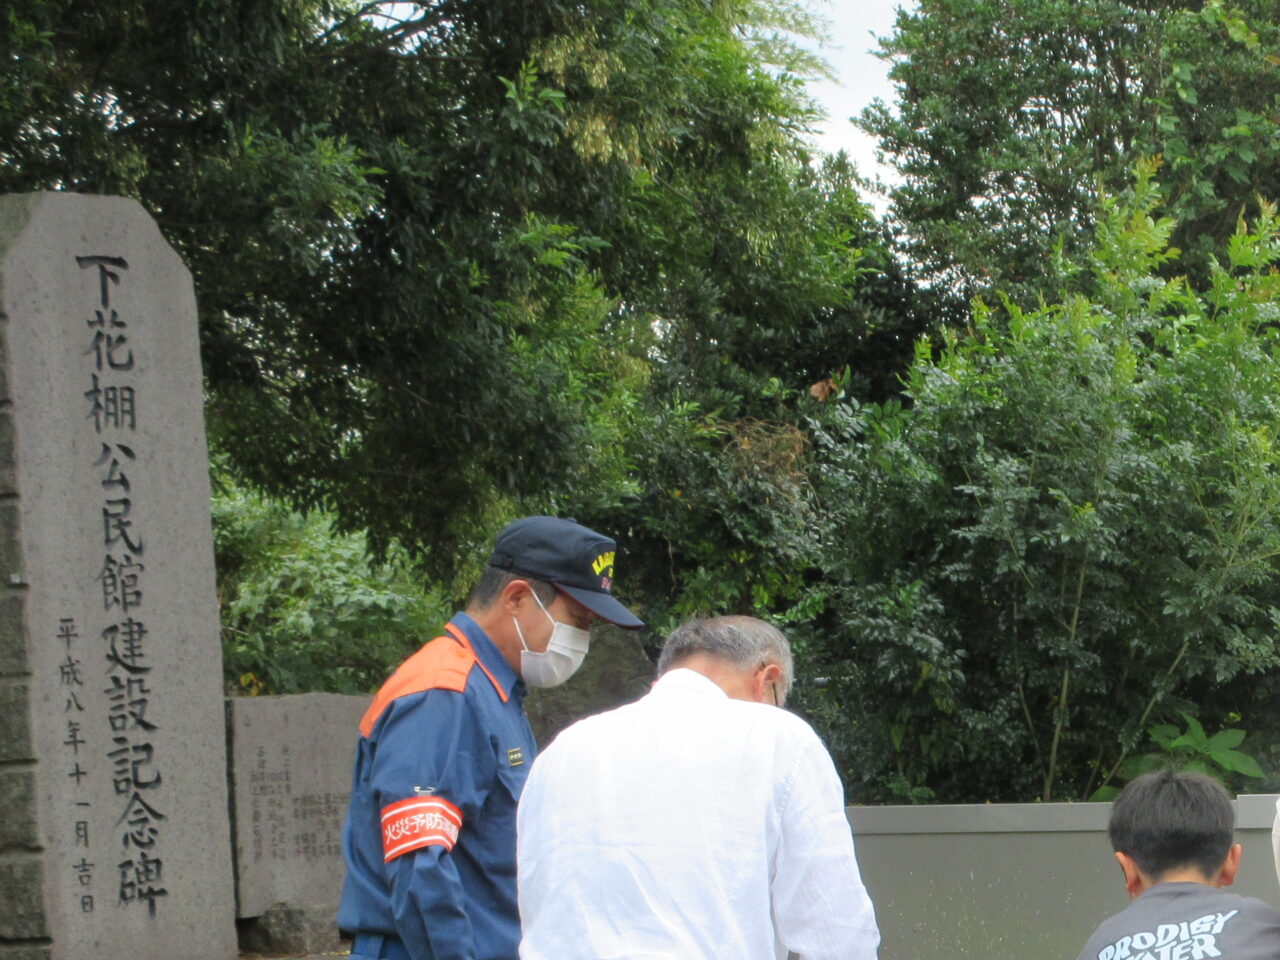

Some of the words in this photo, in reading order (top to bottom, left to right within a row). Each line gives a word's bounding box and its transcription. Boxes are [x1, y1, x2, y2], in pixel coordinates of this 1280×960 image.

[56, 617, 95, 914] 平成八年十一月吉日
[75, 255, 168, 920] 下花棚公民館建設記念碑
